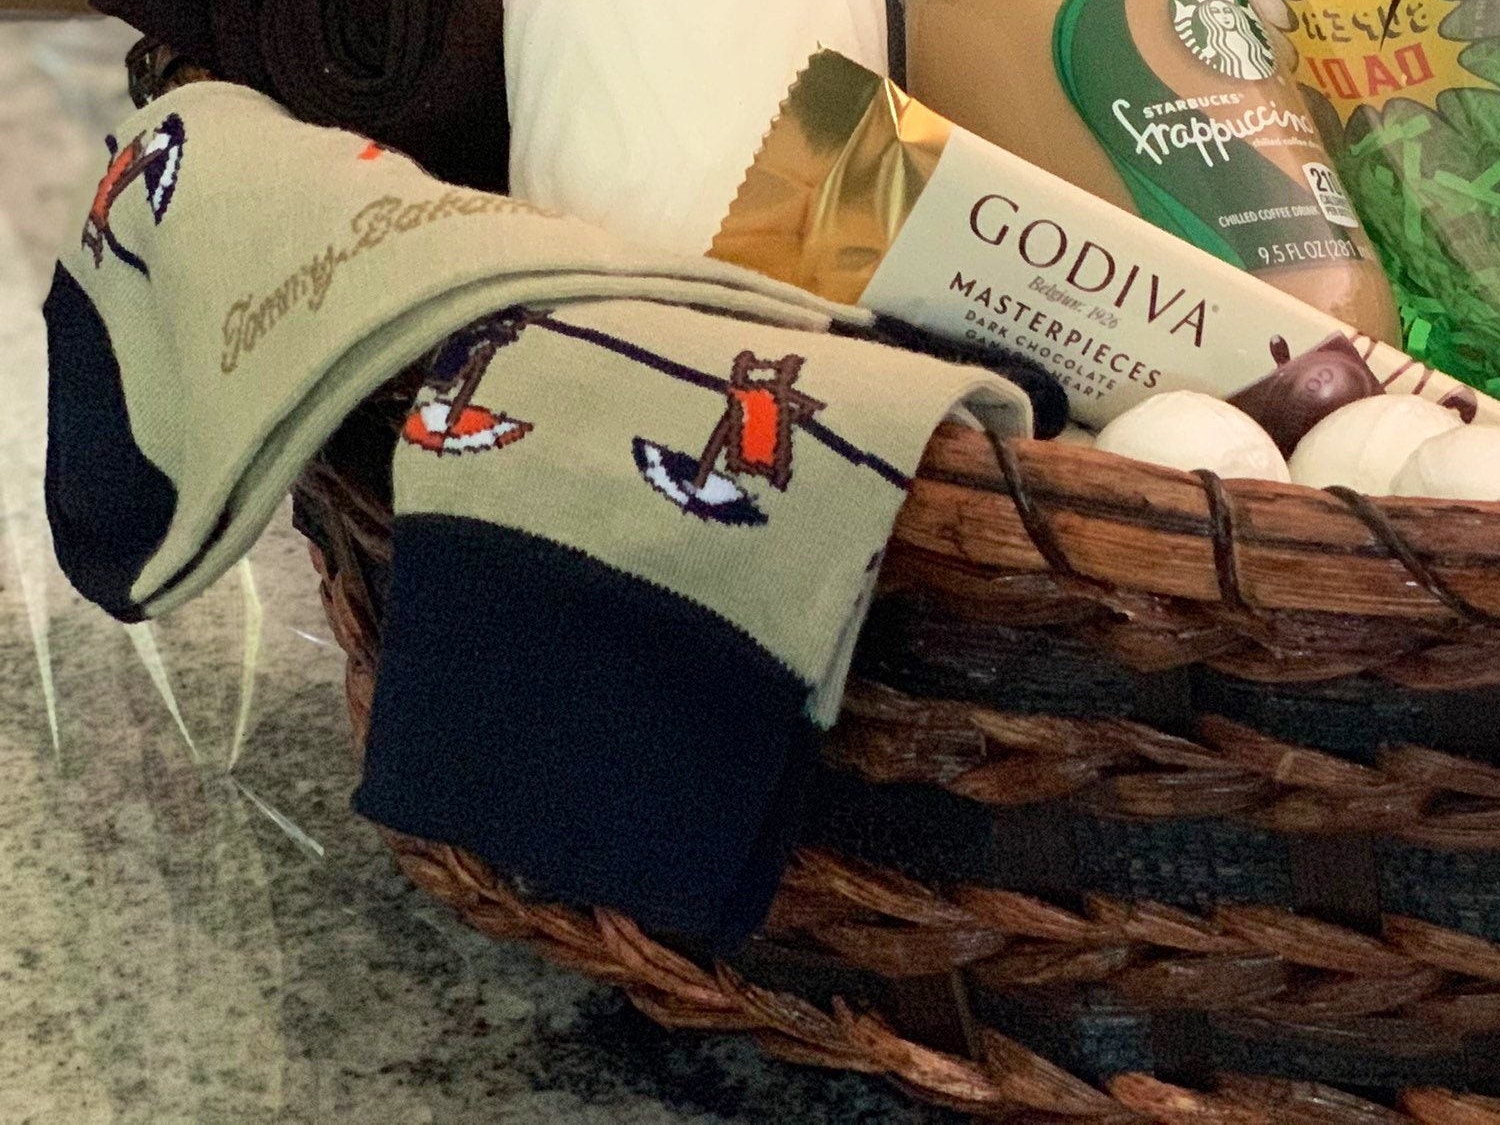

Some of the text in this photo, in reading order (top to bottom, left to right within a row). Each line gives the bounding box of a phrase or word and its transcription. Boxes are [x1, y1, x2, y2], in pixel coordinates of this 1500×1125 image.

[1143, 94, 1240, 119] STARBUCKS
[1219, 211, 1258, 227] CHILLED
[1258, 207, 1291, 222] COFFEE
[1291, 204, 1322, 217] DRINK
[970, 194, 1205, 348] GODIVA
[1258, 247, 1285, 265] 9.5
[1286, 243, 1302, 261] FL
[1304, 240, 1325, 259] OZ
[949, 271, 1162, 388] MASTERPIECES
[965, 309, 1008, 338] DARK
[1015, 335, 1117, 390] CHOCOLATE
